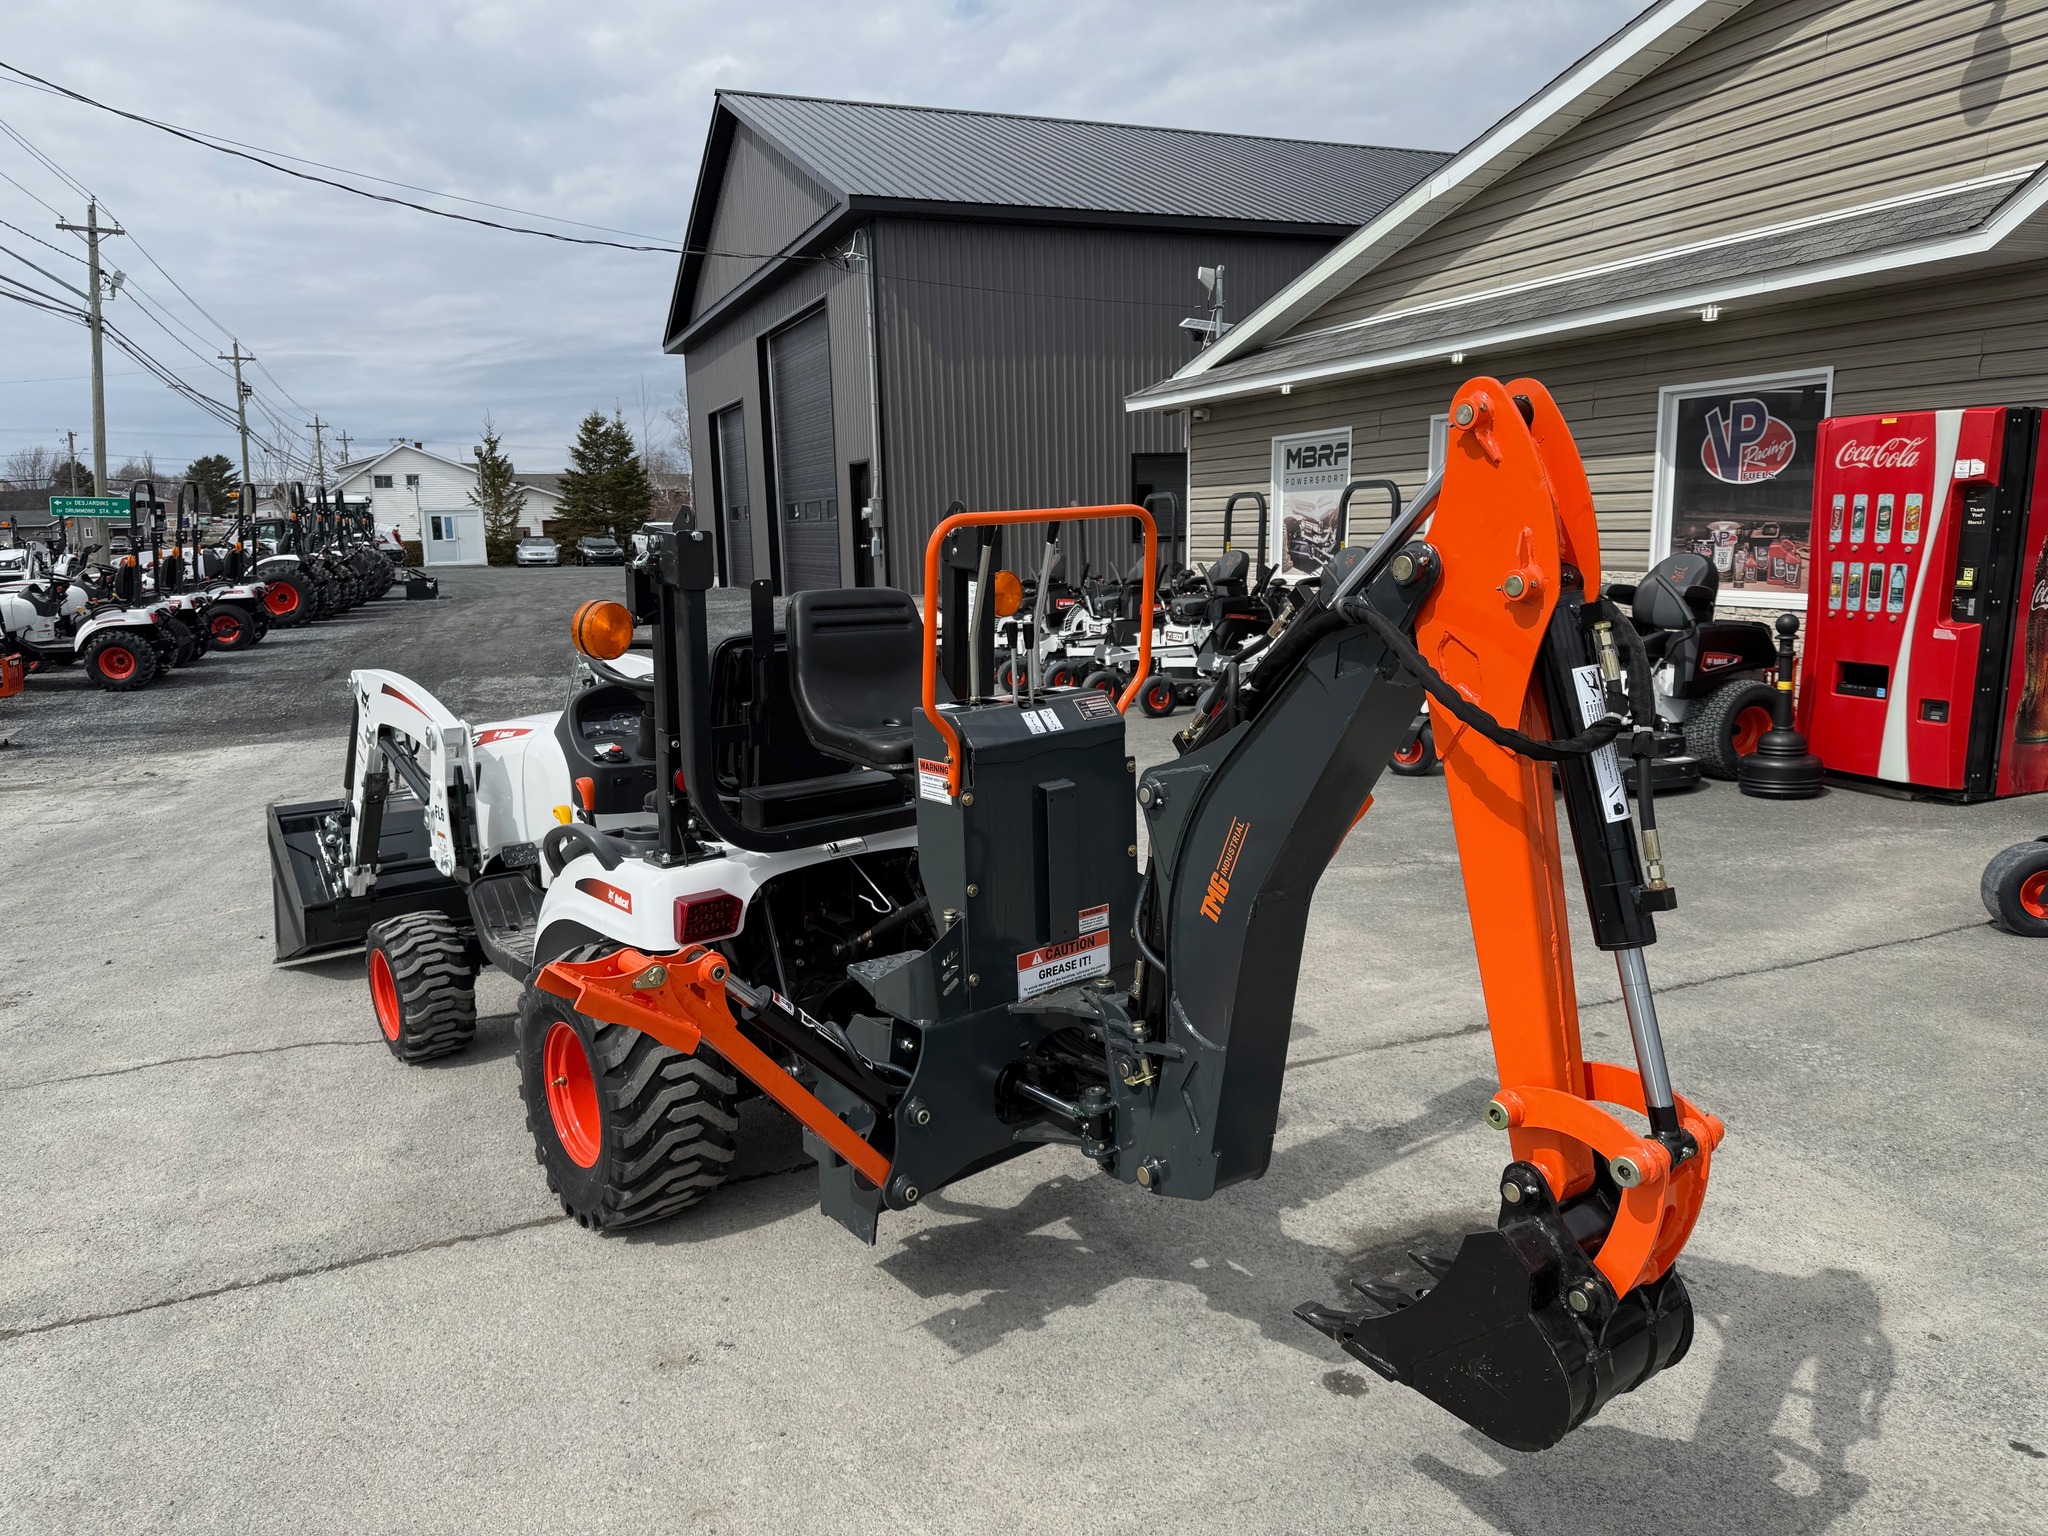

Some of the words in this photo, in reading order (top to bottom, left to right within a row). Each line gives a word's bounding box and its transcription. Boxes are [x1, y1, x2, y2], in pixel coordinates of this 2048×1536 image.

[1705, 398, 1769, 482] VP
[1835, 437, 1928, 469] Coca-Cola
[1286, 442, 1349, 470] MBRP
[1743, 440, 1792, 471] Racing
[1286, 474, 1348, 485] POWERSPORT
[920, 761, 948, 774] WARNING
[1200, 871, 1230, 923] TMG
[1220, 822, 1245, 877] INDUSTRIAL
[614, 894, 629, 909] Bobcat
[1045, 936, 1095, 959] CAUTION
[1038, 959, 1077, 980] GREASE
[1079, 955, 1091, 967] IT!
